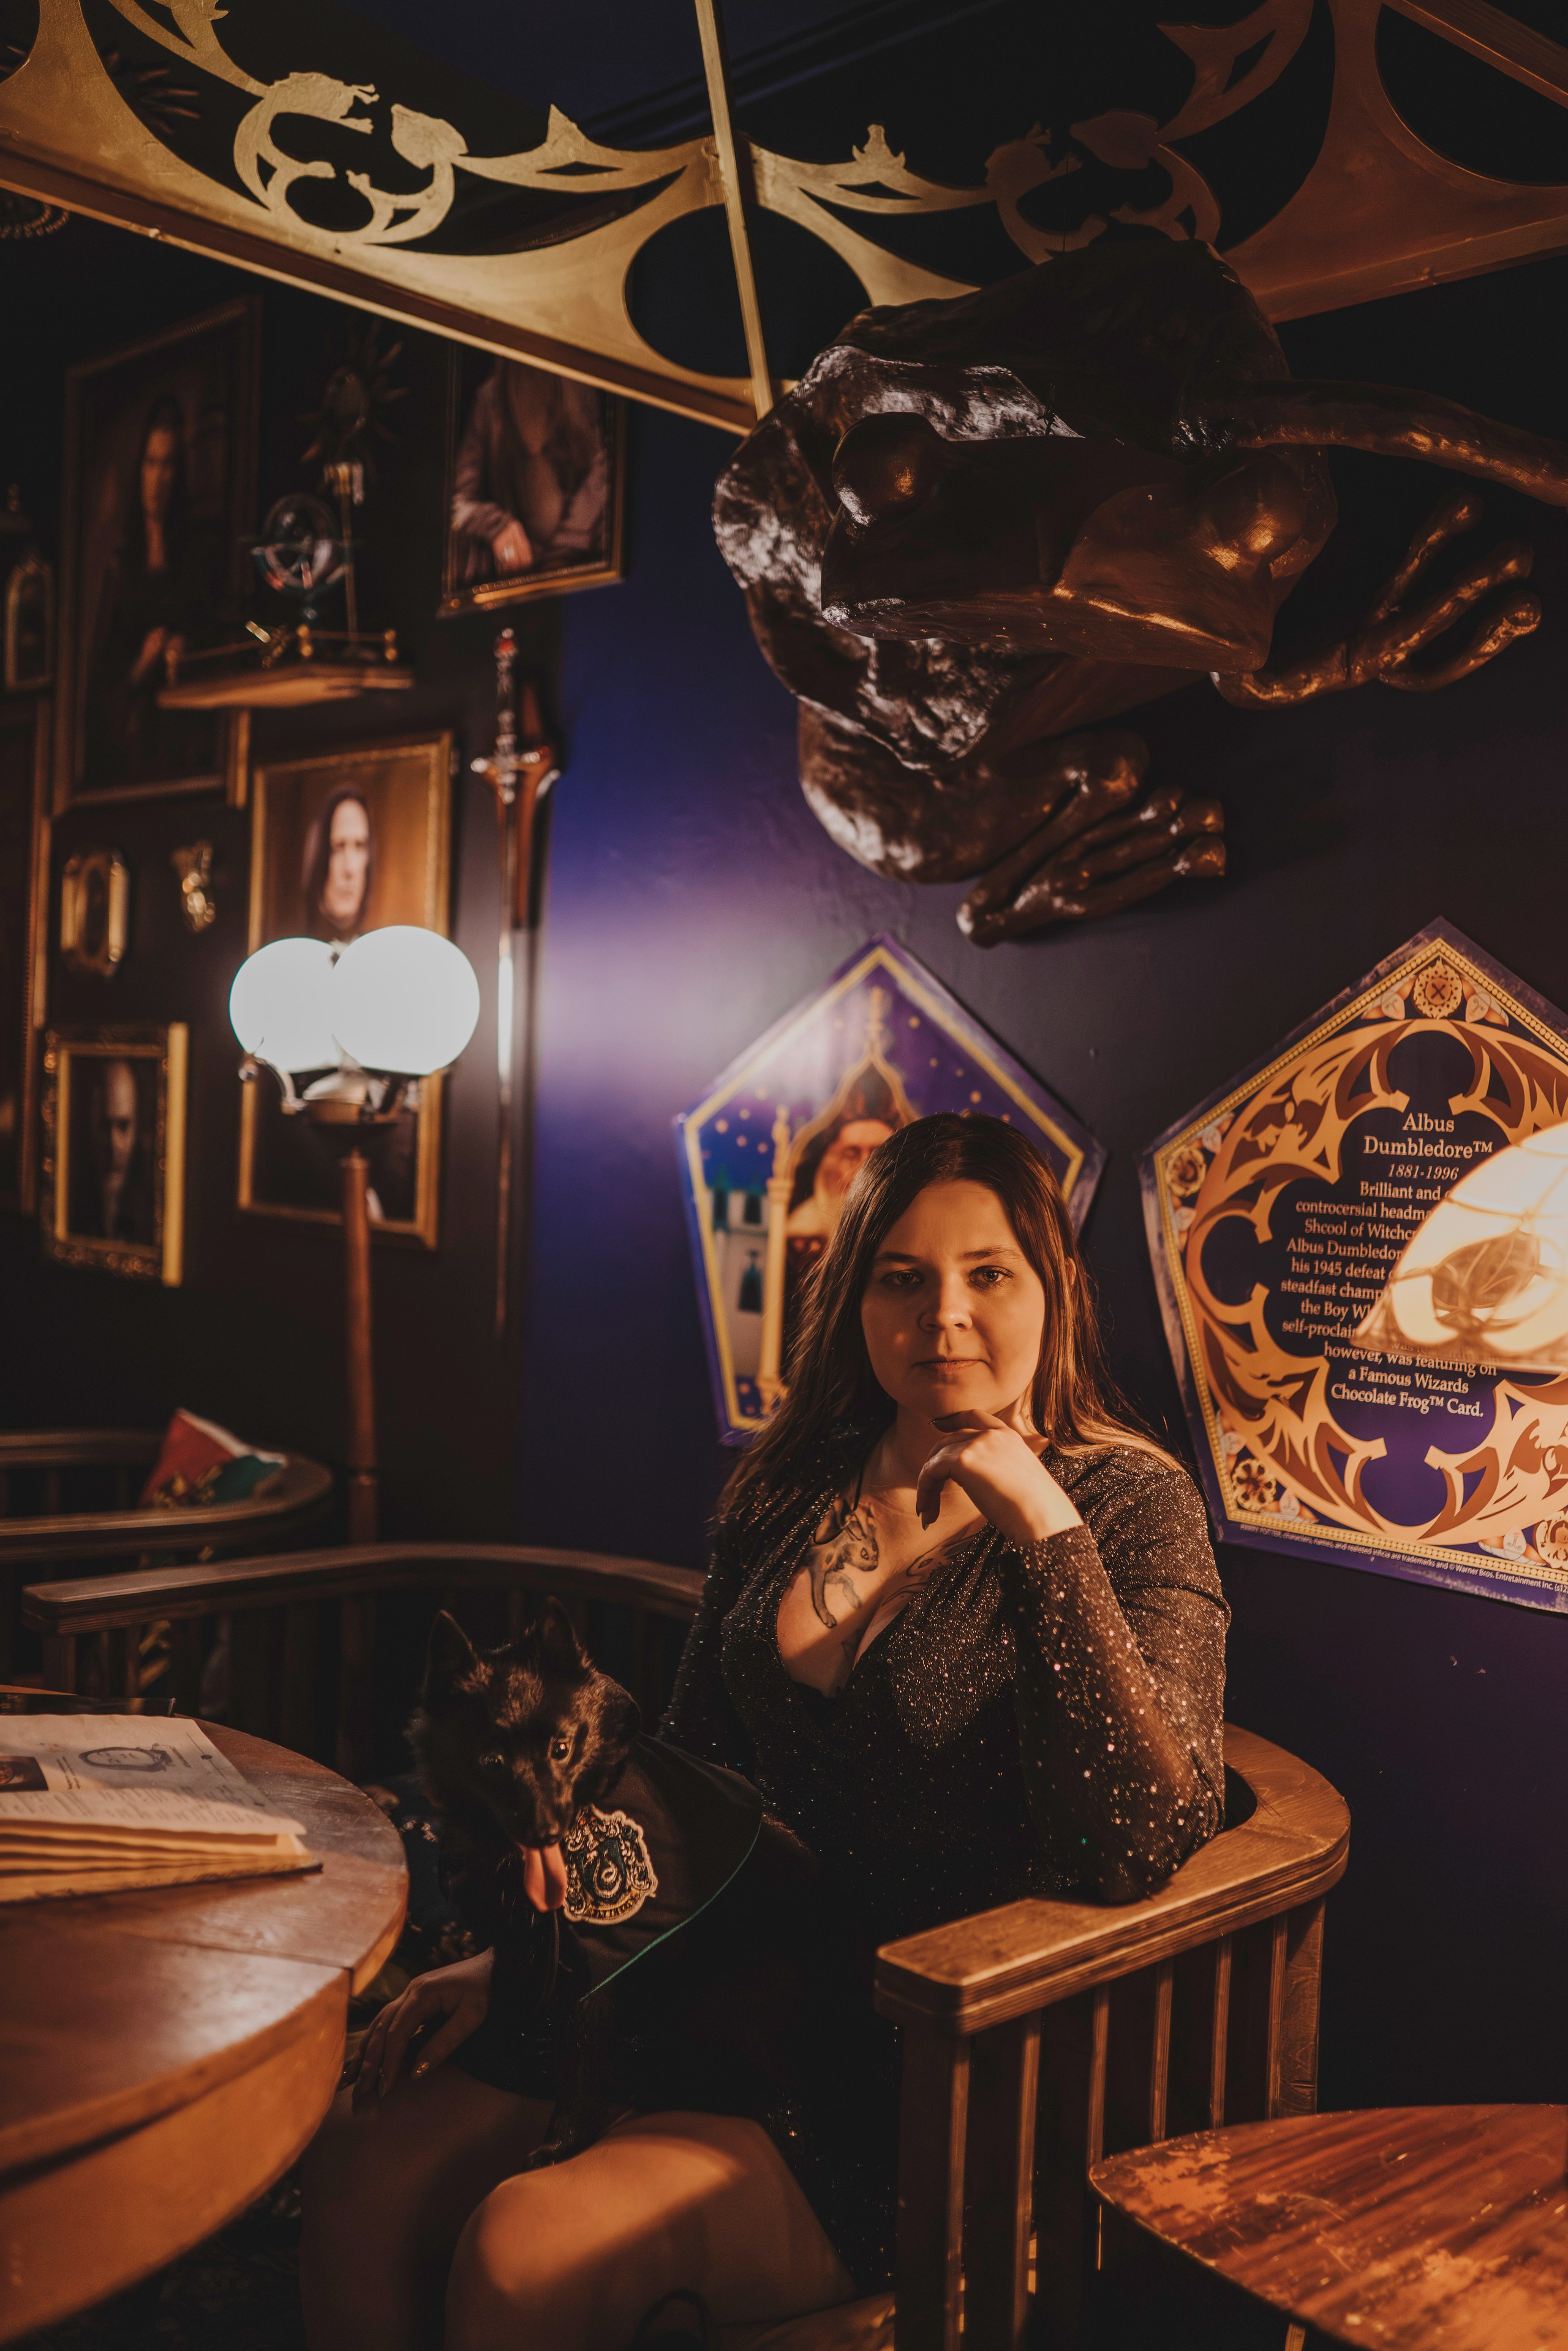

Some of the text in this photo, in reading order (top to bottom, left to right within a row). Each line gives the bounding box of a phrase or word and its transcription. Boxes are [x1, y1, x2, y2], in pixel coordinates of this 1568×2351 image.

[1403, 1112, 1455, 1133] Albus
[1388, 1164, 1460, 1180] 1881-1996
[1360, 1181, 1412, 1199] Brilliant
[1416, 1185, 1441, 1201] and
[1305, 1218, 1347, 1236] Shcool
[1351, 1222, 1364, 1237] of
[1286, 1237, 1324, 1255] Albus
[1291, 1256, 1310, 1274] his
[1313, 1259, 1342, 1277] 1945
[1345, 1262, 1385, 1280] defeat
[1281, 1278, 1336, 1296] steadfast
[1301, 1298, 1321, 1315] the
[1324, 1300, 1349, 1322] Boy
[1324, 1341, 1382, 1364] however,
[1387, 1353, 1412, 1366] was
[1415, 1354, 1476, 1378] featuring
[1479, 1364, 1497, 1376] on
[1348, 1366, 1469, 1394] a Famous Wizards
[1331, 1383, 1396, 1406] Chocolate
[1447, 1398, 1483, 1417] Card.
[1335, 1542, 1347, 1550] and
[1401, 1554, 1436, 1568] trademarks
[1455, 1564, 1479, 1576] Warner
